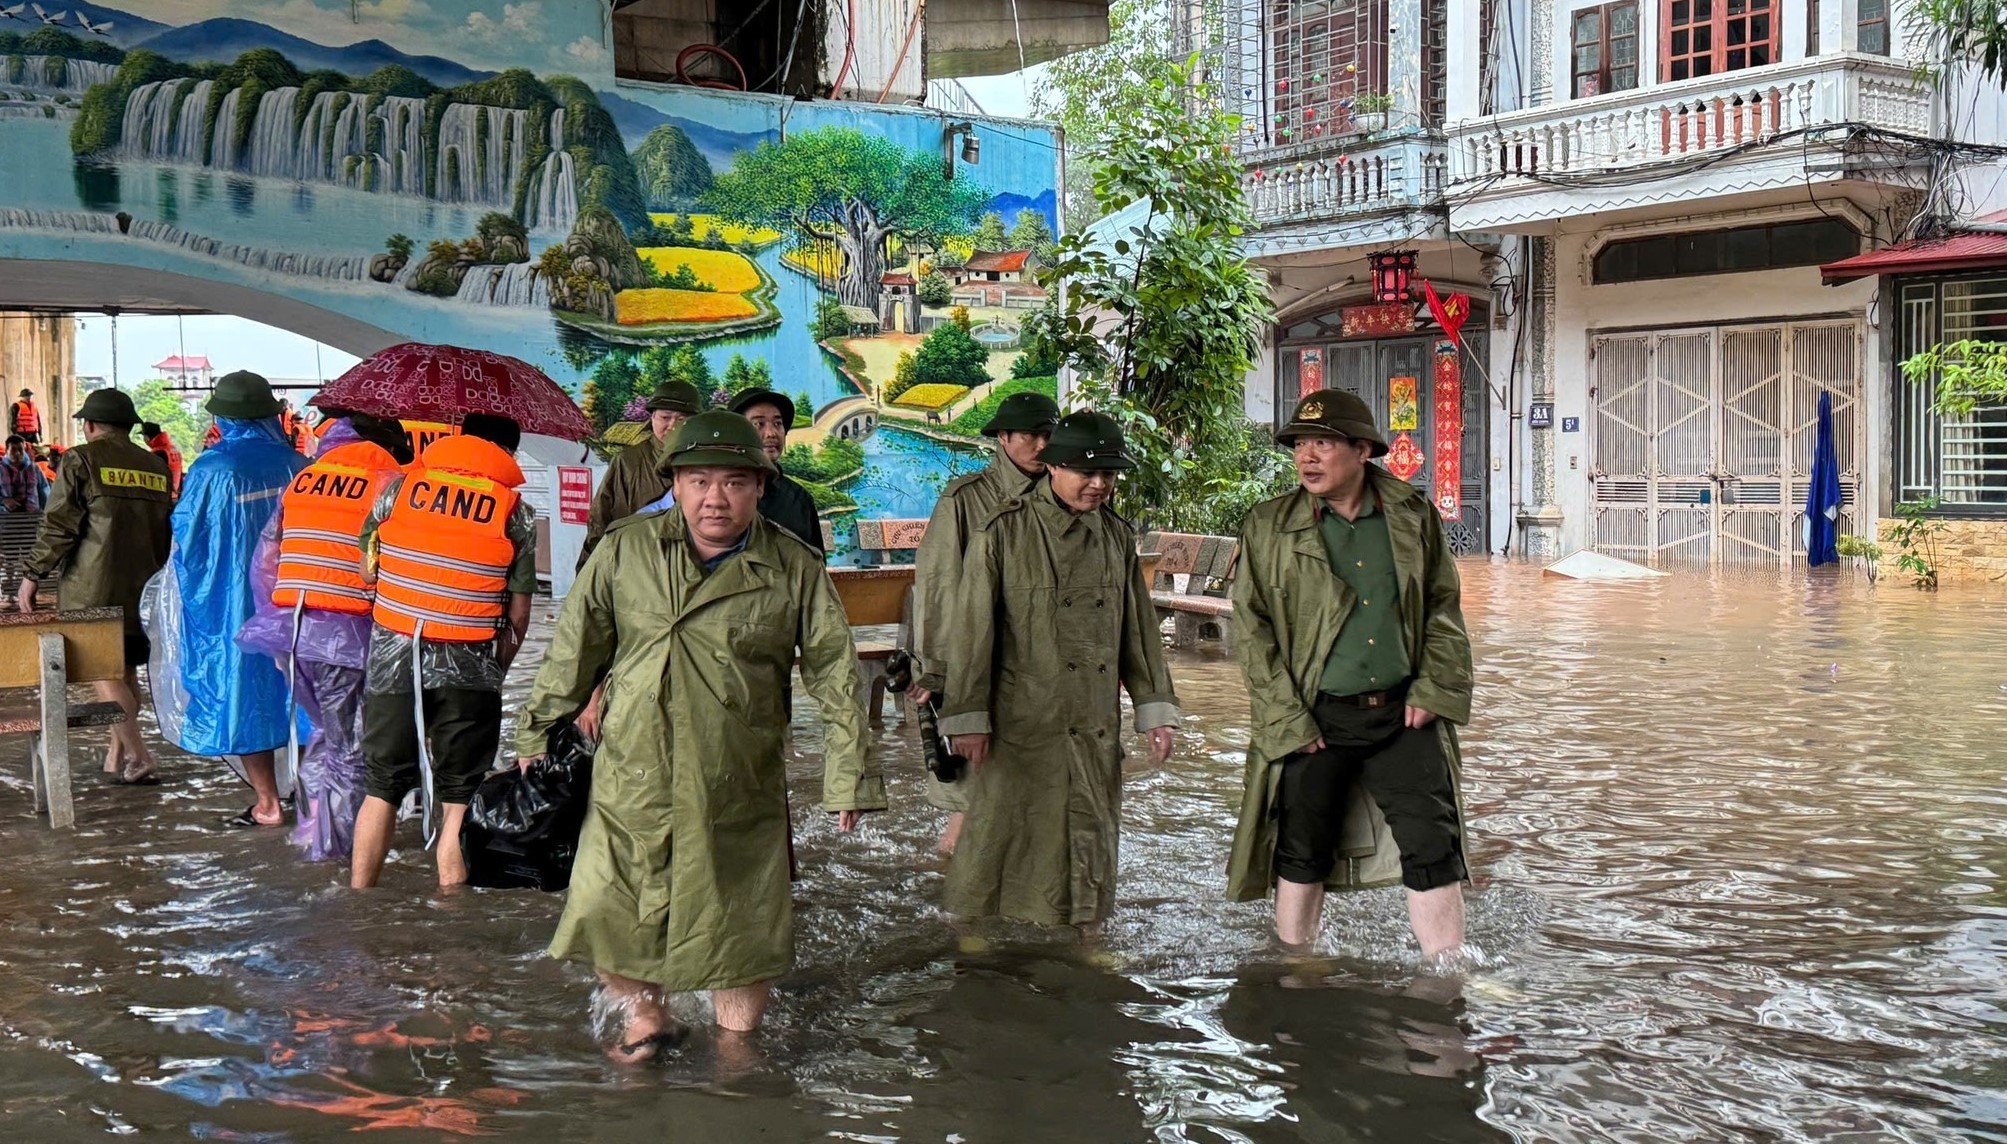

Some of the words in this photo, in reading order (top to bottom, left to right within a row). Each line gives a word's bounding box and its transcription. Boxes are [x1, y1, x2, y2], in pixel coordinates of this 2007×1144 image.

[1533, 407, 1549, 420] 3A
[405, 430, 452, 455] AN
[293, 472, 369, 500] CAND
[409, 481, 497, 524] CAND
